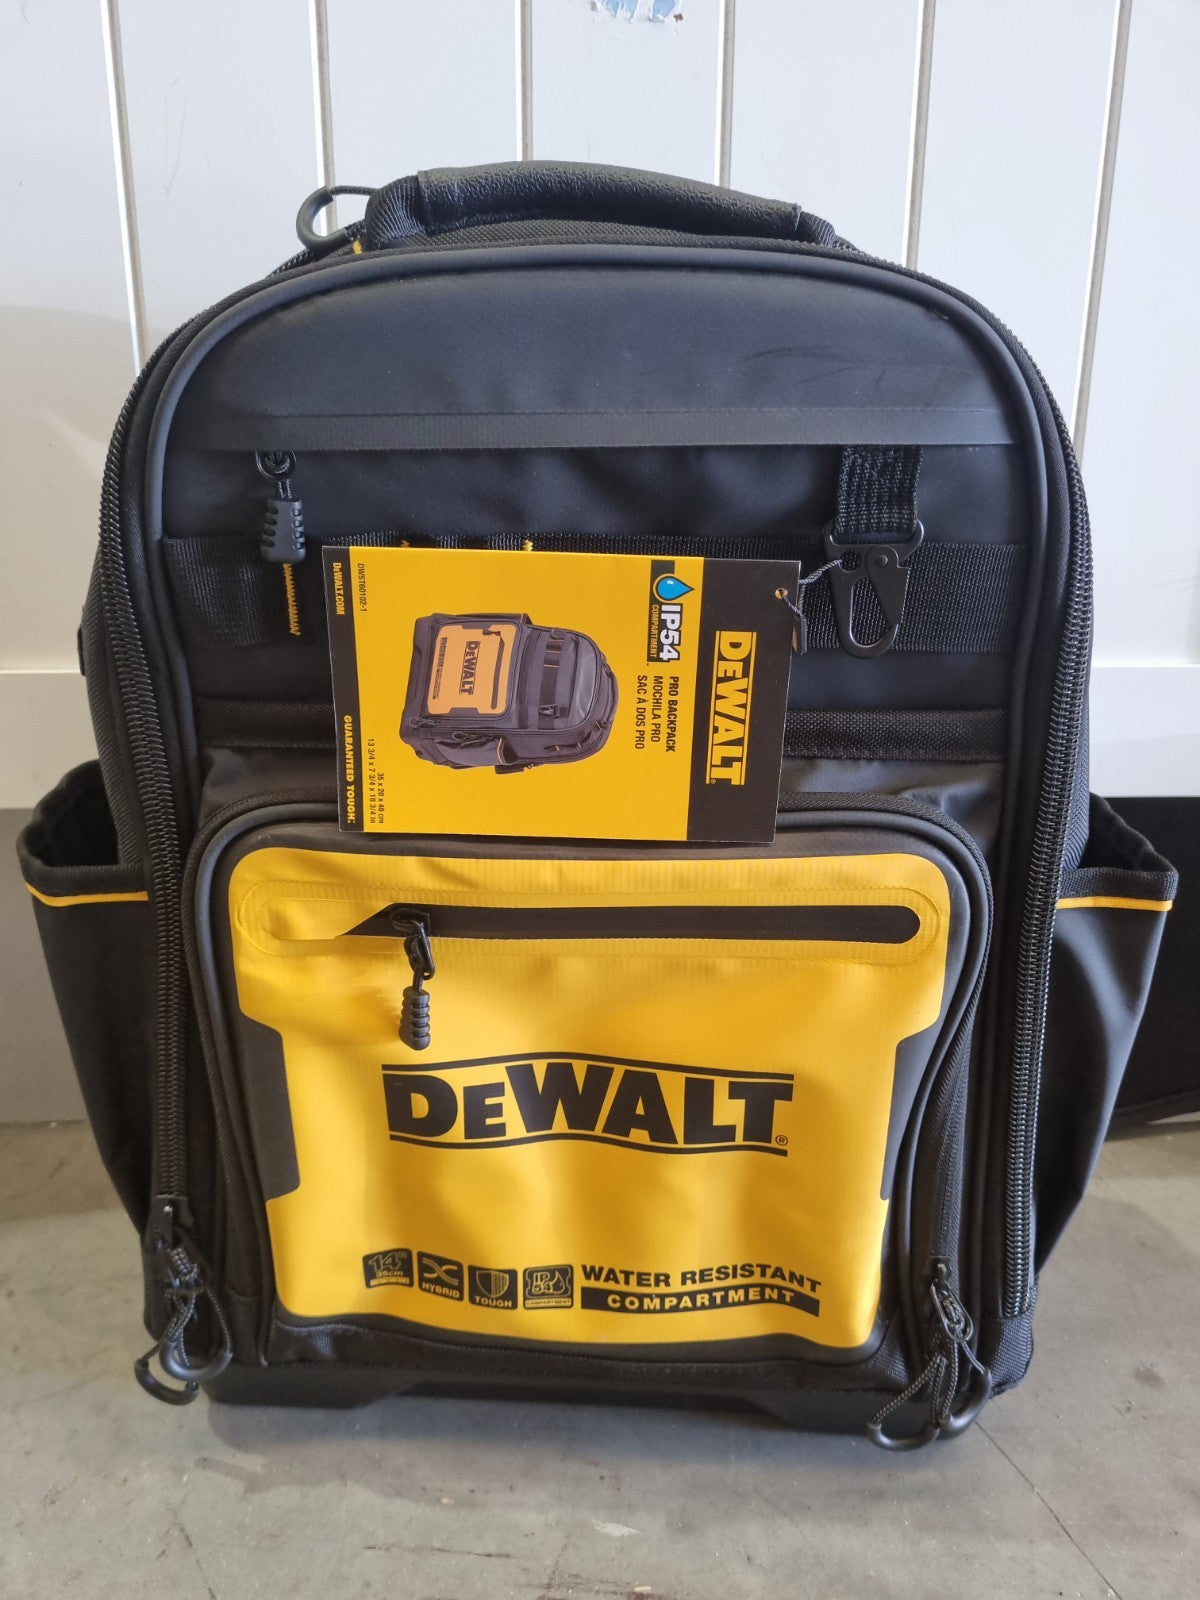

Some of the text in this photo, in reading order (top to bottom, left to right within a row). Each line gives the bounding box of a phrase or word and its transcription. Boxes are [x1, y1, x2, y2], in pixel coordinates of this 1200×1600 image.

[357, 563, 368, 612] DWST60102-1
[650, 604, 660, 658] COMPARTMENT
[659, 604, 681, 661] IP54
[636, 675, 648, 695] SAC
[635, 707, 646, 727] DOS
[650, 675, 664, 743] MOCHILA PRO
[665, 676, 680, 752] PRO BACKPACK
[343, 714, 355, 782] GUARANTEED
[634, 729, 645, 750] PRO
[367, 748, 376, 760] 3/4
[368, 774, 377, 786] 3/4
[369, 804, 377, 817] 3/4
[378, 814, 385, 824] cm
[581, 1263, 822, 1293] WATER RESISTANT
[422, 1281, 459, 1299] HYBRID
[607, 1287, 795, 1310] COMPARTMENT
[475, 1296, 512, 1309] TOUGH
